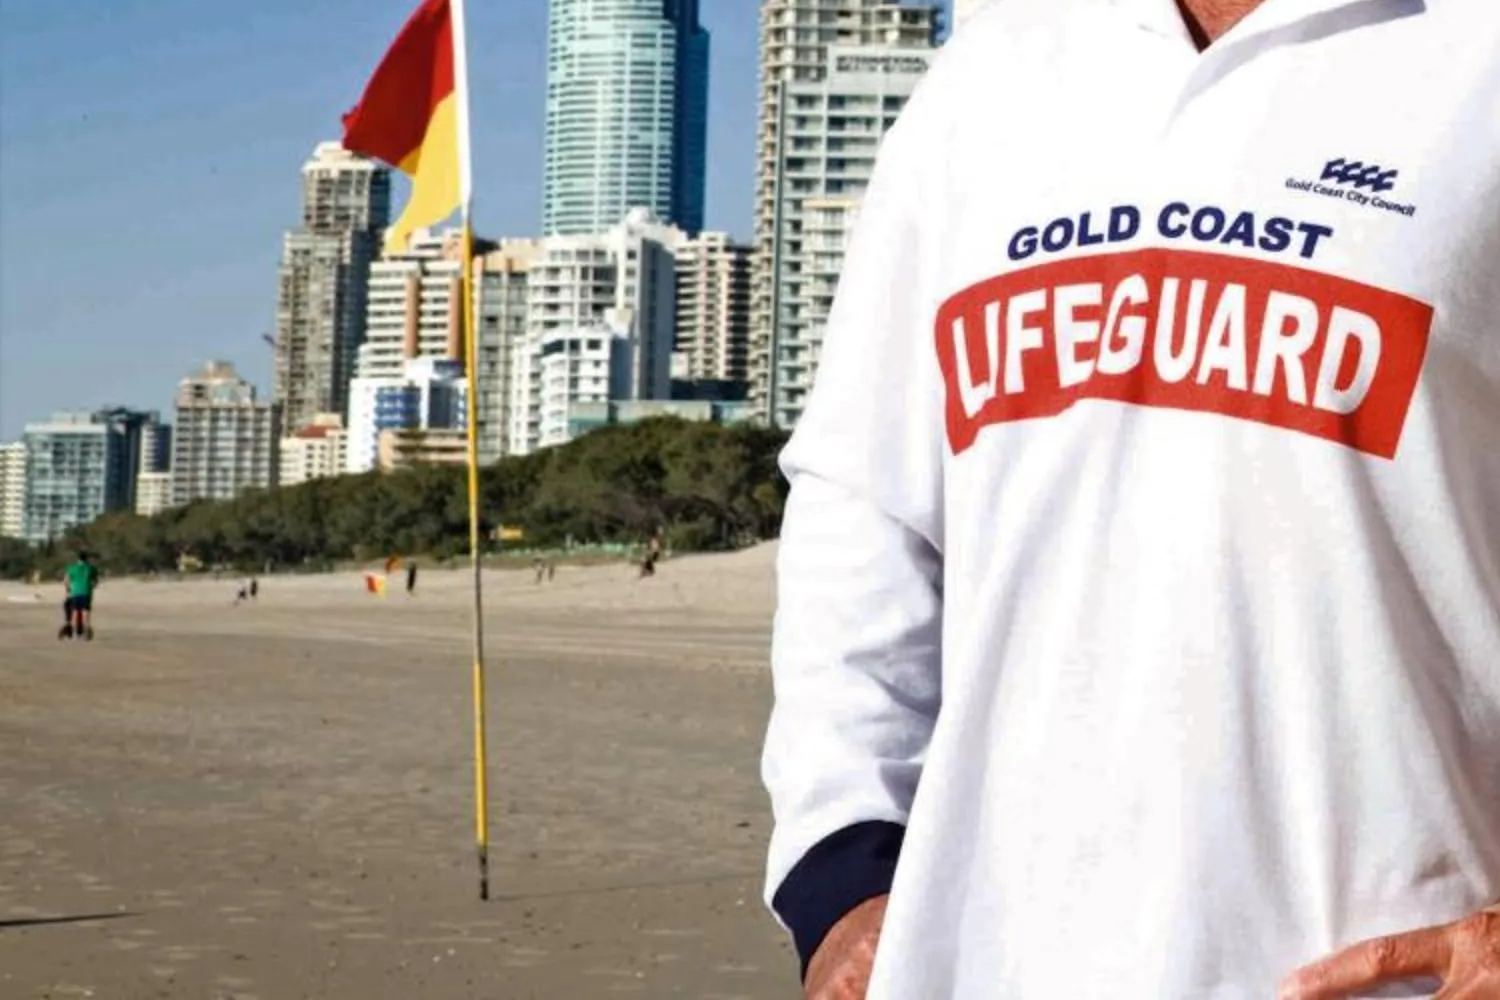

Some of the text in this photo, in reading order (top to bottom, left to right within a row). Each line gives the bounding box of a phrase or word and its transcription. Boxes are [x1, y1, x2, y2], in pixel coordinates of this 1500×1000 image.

[1285, 178, 1417, 216] Gold Coast City Council
[1008, 202, 1334, 261] GOLD COAST
[952, 273, 1383, 420] LIFEGUARD
